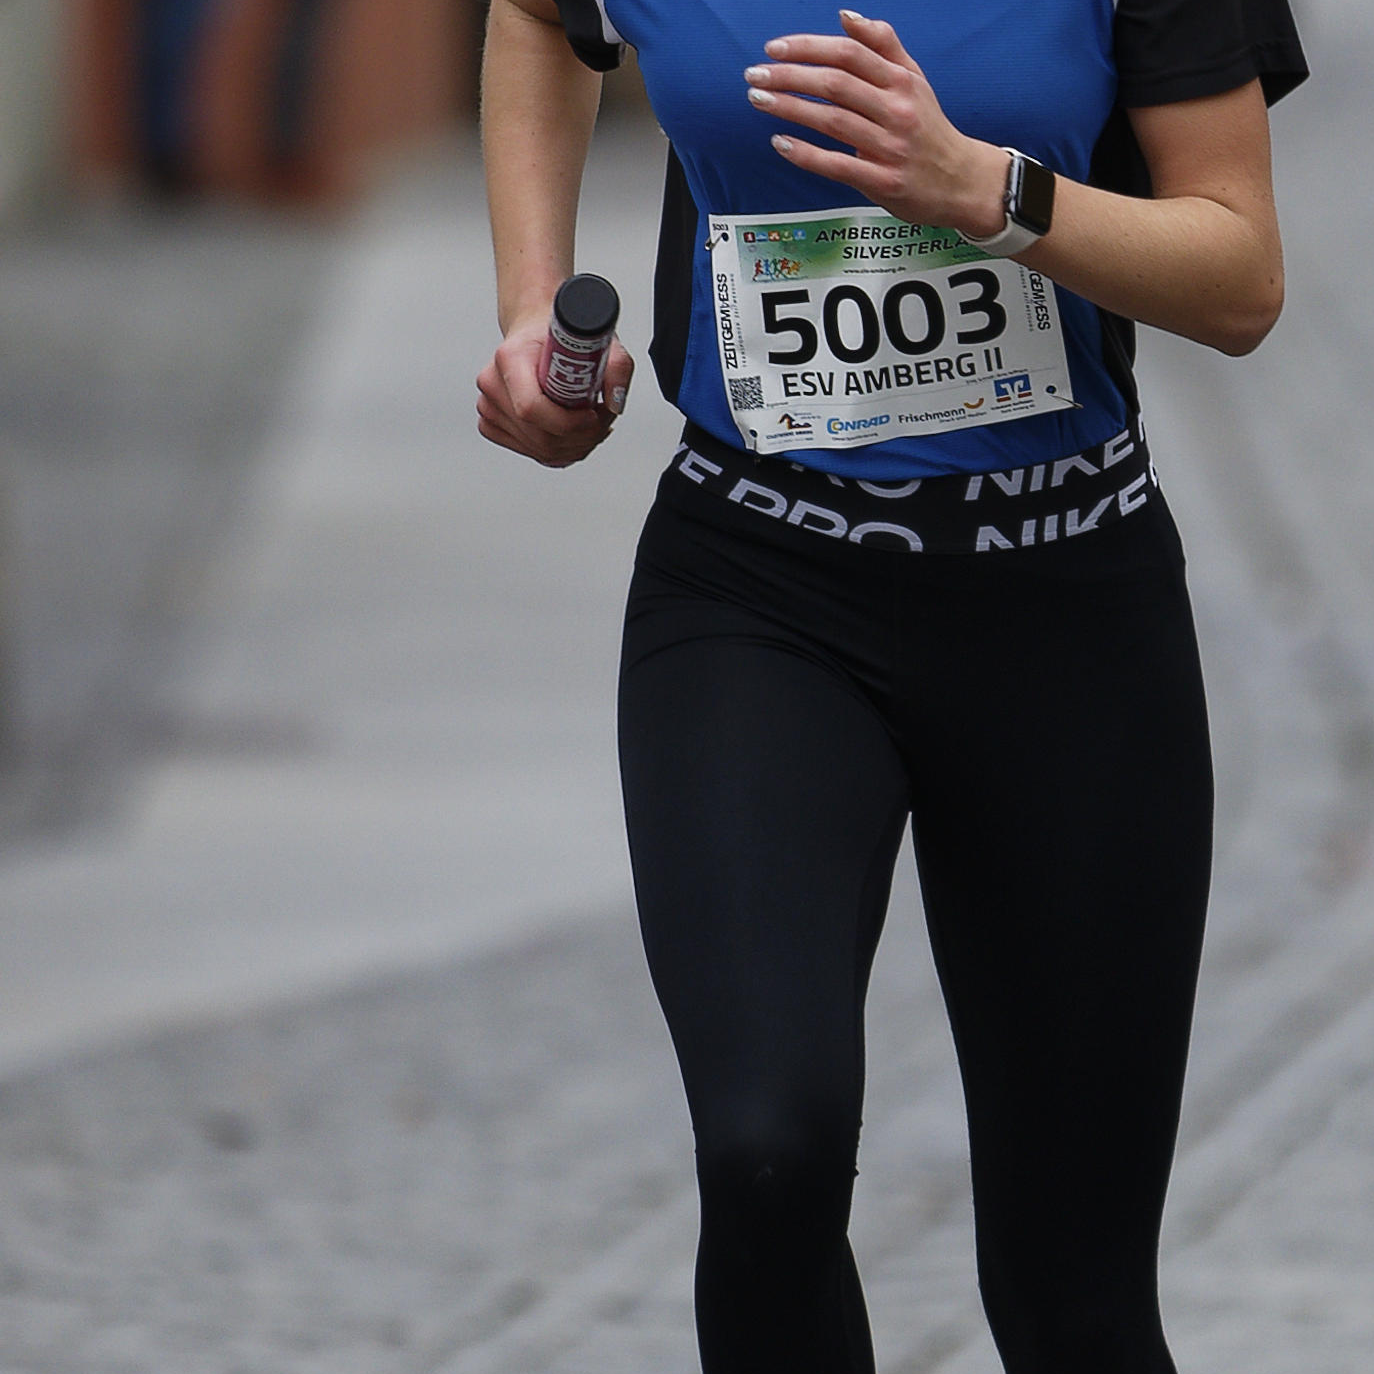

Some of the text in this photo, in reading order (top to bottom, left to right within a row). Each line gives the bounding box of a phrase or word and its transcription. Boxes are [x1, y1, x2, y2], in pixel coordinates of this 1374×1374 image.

[815, 225, 923, 243] AMBERGER
[842, 236, 969, 259] SILVESTERLA
[761, 268, 1007, 366] 5003
[782, 371, 834, 398] ESV
[845, 352, 976, 396] AMBERG
[984, 346, 1003, 372] II
[826, 414, 891, 435] CONRAD
[898, 407, 966, 424] Frischmann
